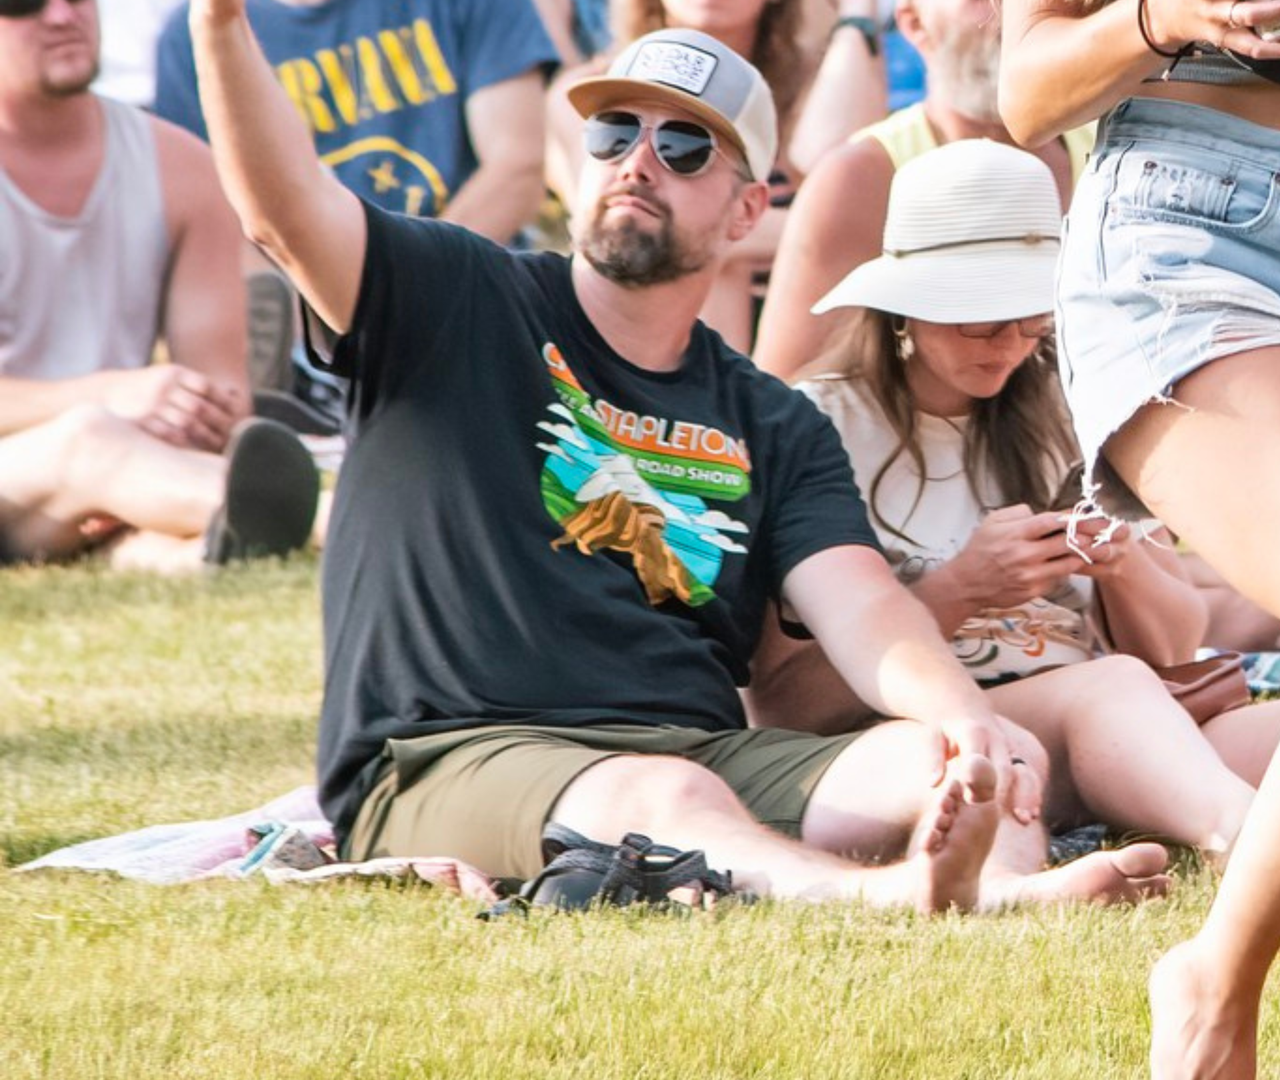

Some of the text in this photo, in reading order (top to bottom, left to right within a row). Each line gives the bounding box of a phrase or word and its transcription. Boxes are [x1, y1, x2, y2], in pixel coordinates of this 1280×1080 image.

[278, 18, 457, 133] RVANA
[635, 459, 743, 487] ROAD SHOW
